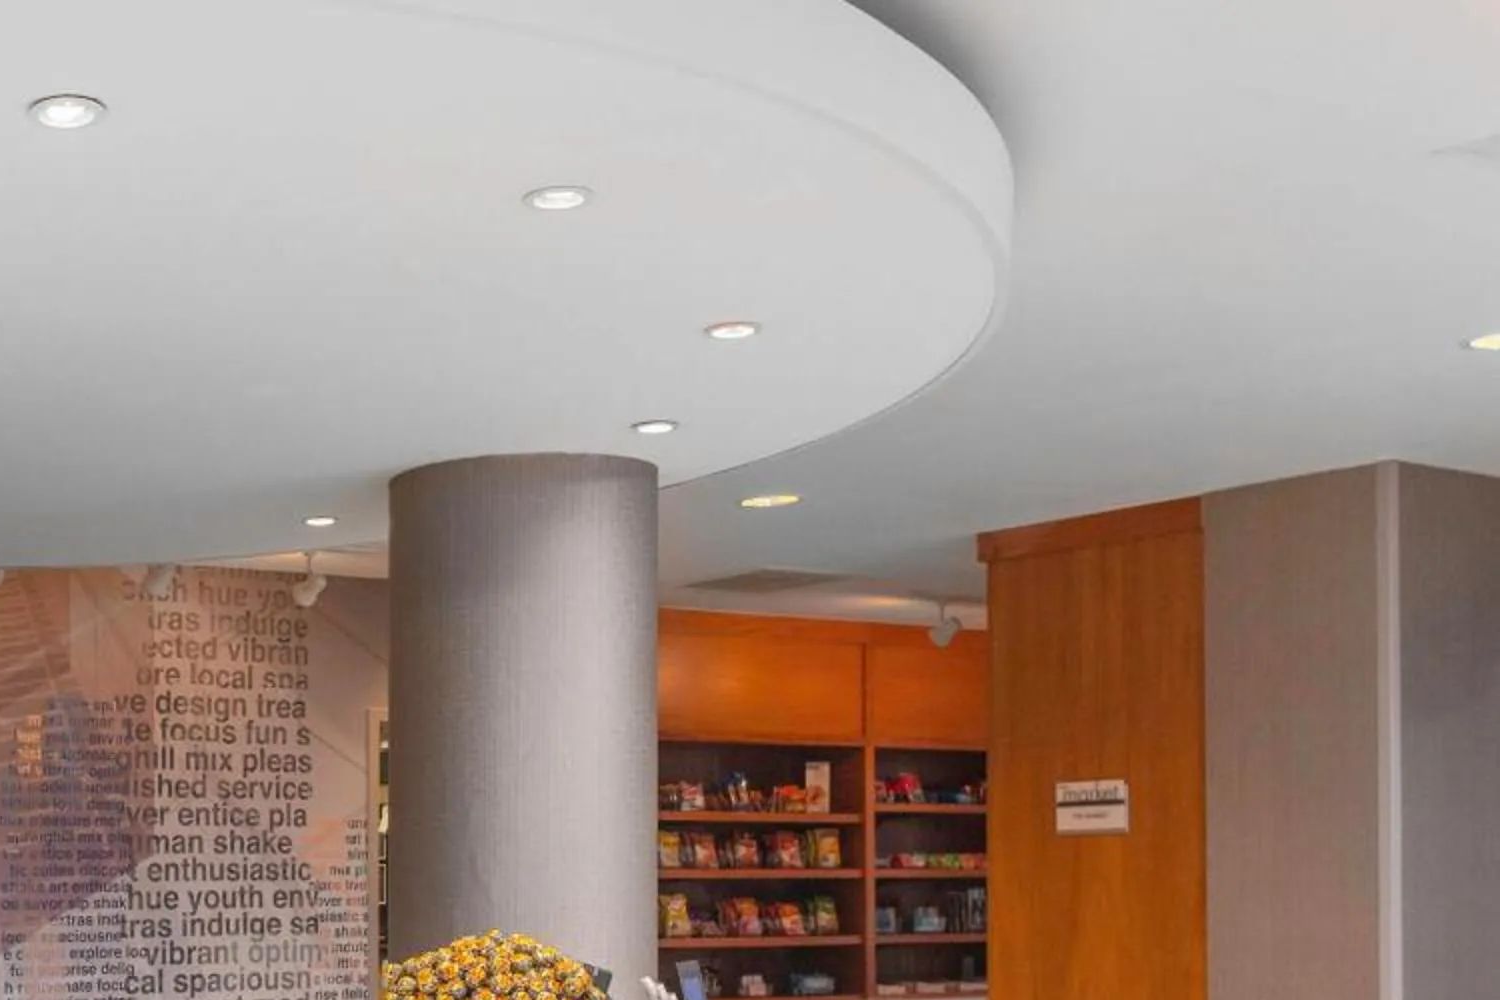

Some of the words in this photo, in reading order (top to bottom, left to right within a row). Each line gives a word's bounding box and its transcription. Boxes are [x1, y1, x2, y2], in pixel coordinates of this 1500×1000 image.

[227, 636, 309, 666] vibran
[189, 662, 253, 690] local
[155, 691, 247, 723] design
[257, 693, 306, 719] trea
[160, 718, 237, 745] focus
[246, 719, 287, 745] fun
[242, 747, 313, 778] pleas
[217, 775, 313, 801] service
[177, 802, 261, 827] entice
[268, 803, 307, 833] pla
[213, 830, 293, 855] shake
[146, 856, 312, 883] enthusiastic
[126, 885, 180, 911] hue
[187, 884, 264, 916] youth
[272, 887, 319, 910] env
[181, 911, 283, 943] indulge
[289, 916, 320, 937] sa
[145, 939, 239, 967] vibrant
[124, 969, 164, 996] cal
[173, 961, 311, 998] spaciousn
